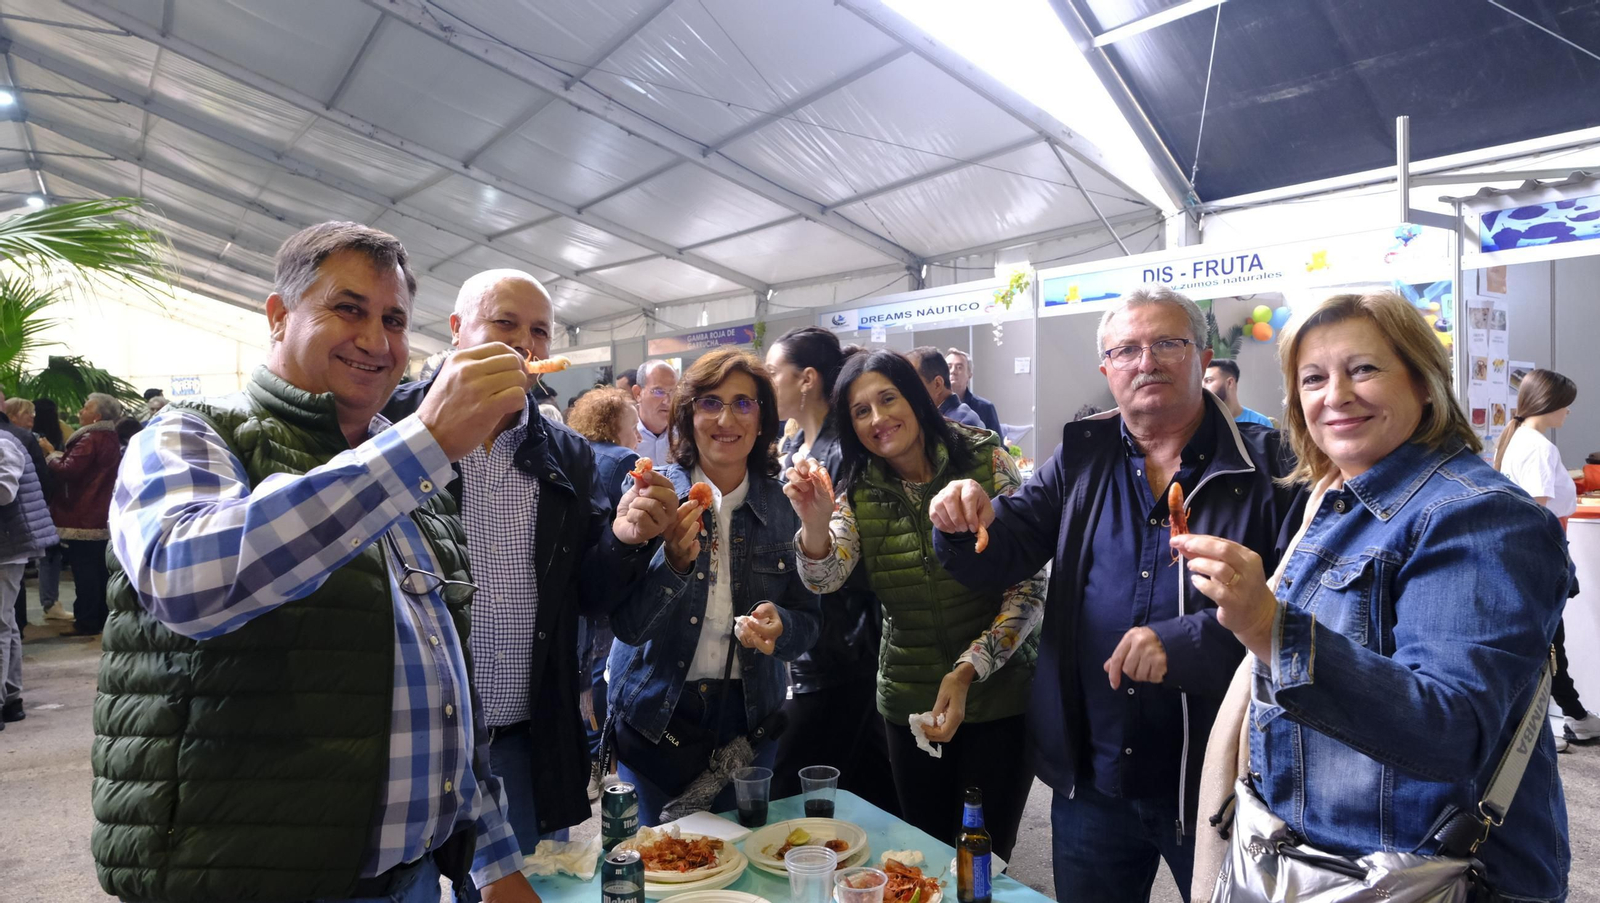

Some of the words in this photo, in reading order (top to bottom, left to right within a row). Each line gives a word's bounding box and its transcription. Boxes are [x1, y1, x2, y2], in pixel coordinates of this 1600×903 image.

[1143, 266, 1173, 283] DIS
[1193, 253, 1264, 279] FRUTA
[1180, 279, 1219, 290] zumos
[1223, 271, 1283, 285] naturales
[860, 311, 912, 325] DREAMS
[916, 302, 980, 317] NÁUTICO
[687, 334, 709, 343] GAMBA
[709, 331, 726, 340] ROJA
[727, 329, 735, 337] DE
[665, 733, 680, 747] LOLA
